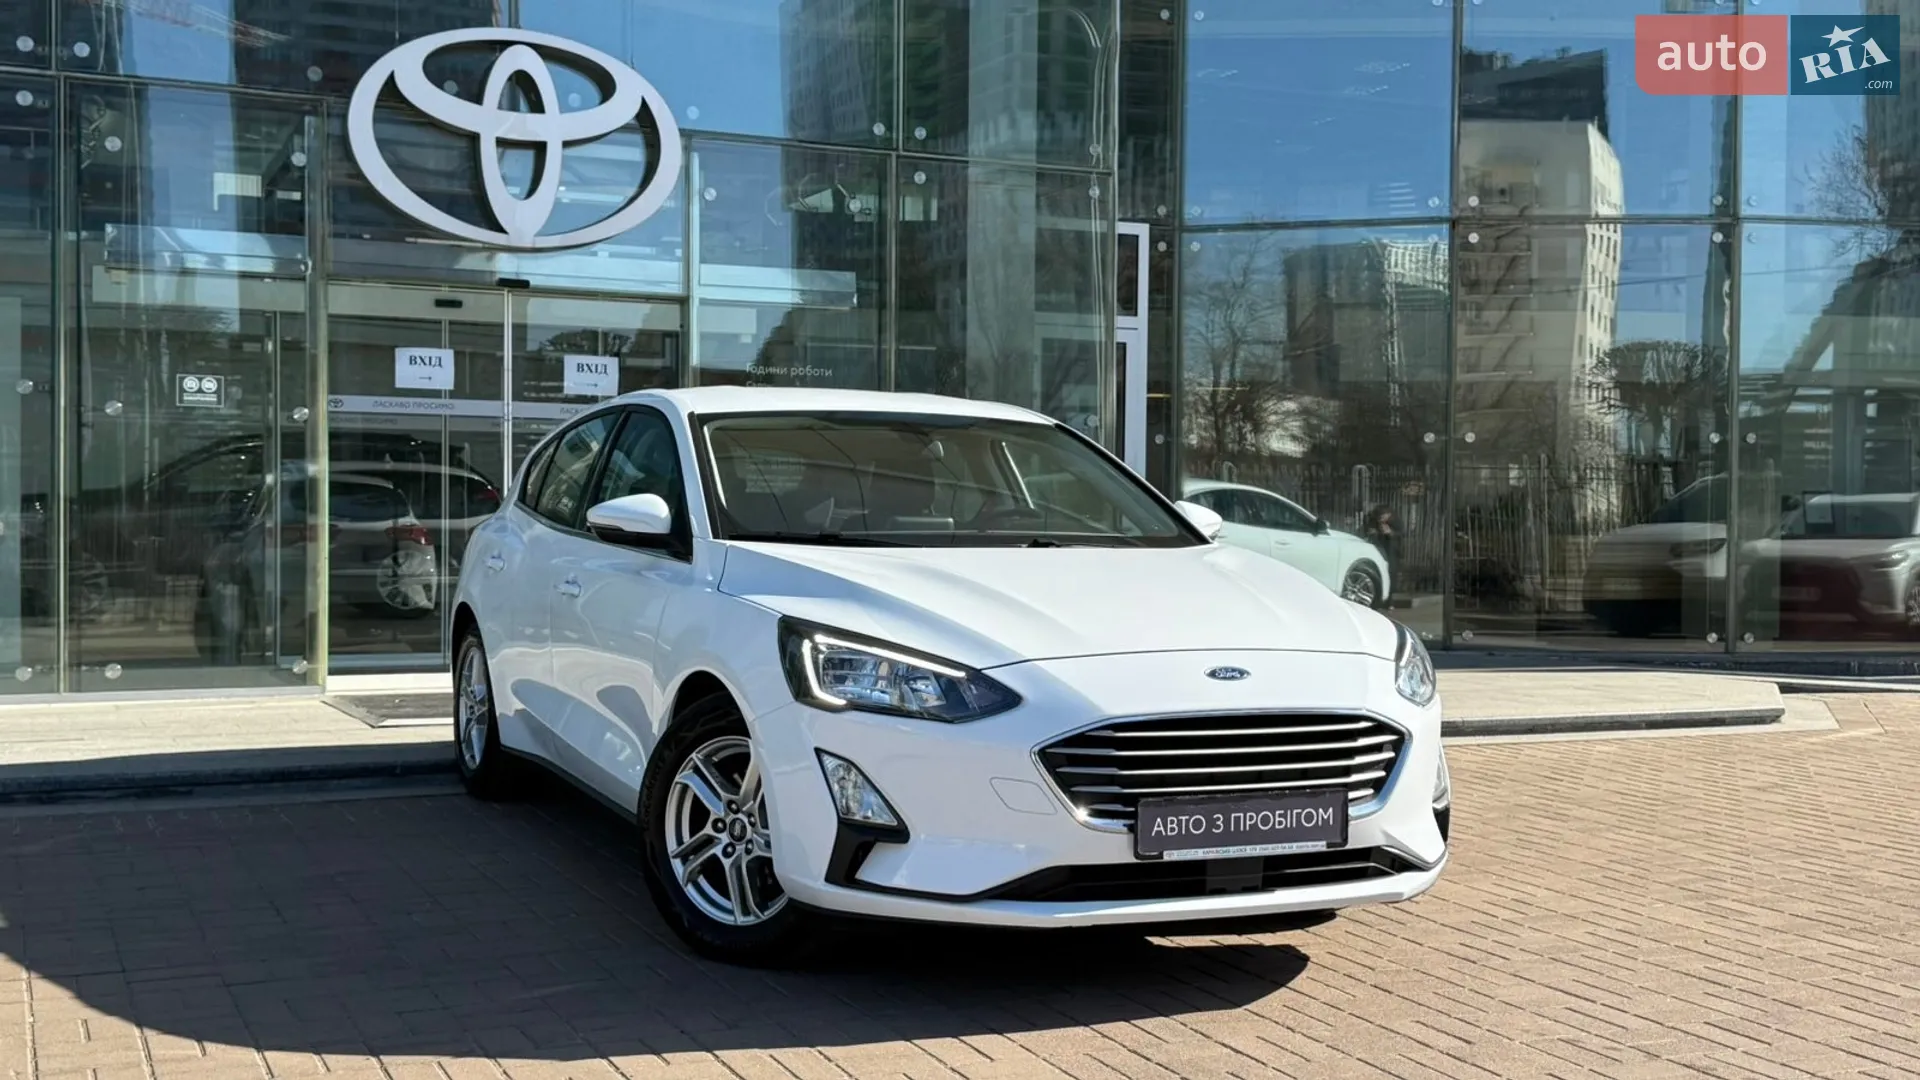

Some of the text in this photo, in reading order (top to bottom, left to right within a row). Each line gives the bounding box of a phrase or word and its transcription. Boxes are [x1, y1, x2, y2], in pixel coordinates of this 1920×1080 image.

[408, 354, 443, 369] ВХІД
[576, 362, 609, 376] ВХІД
[746, 362, 833, 378] Години роботи
[372, 400, 455, 410] ЛАСКАВО ПРОСИМО
[1151, 807, 1334, 837] АВТО З ПРОБІГОМ
